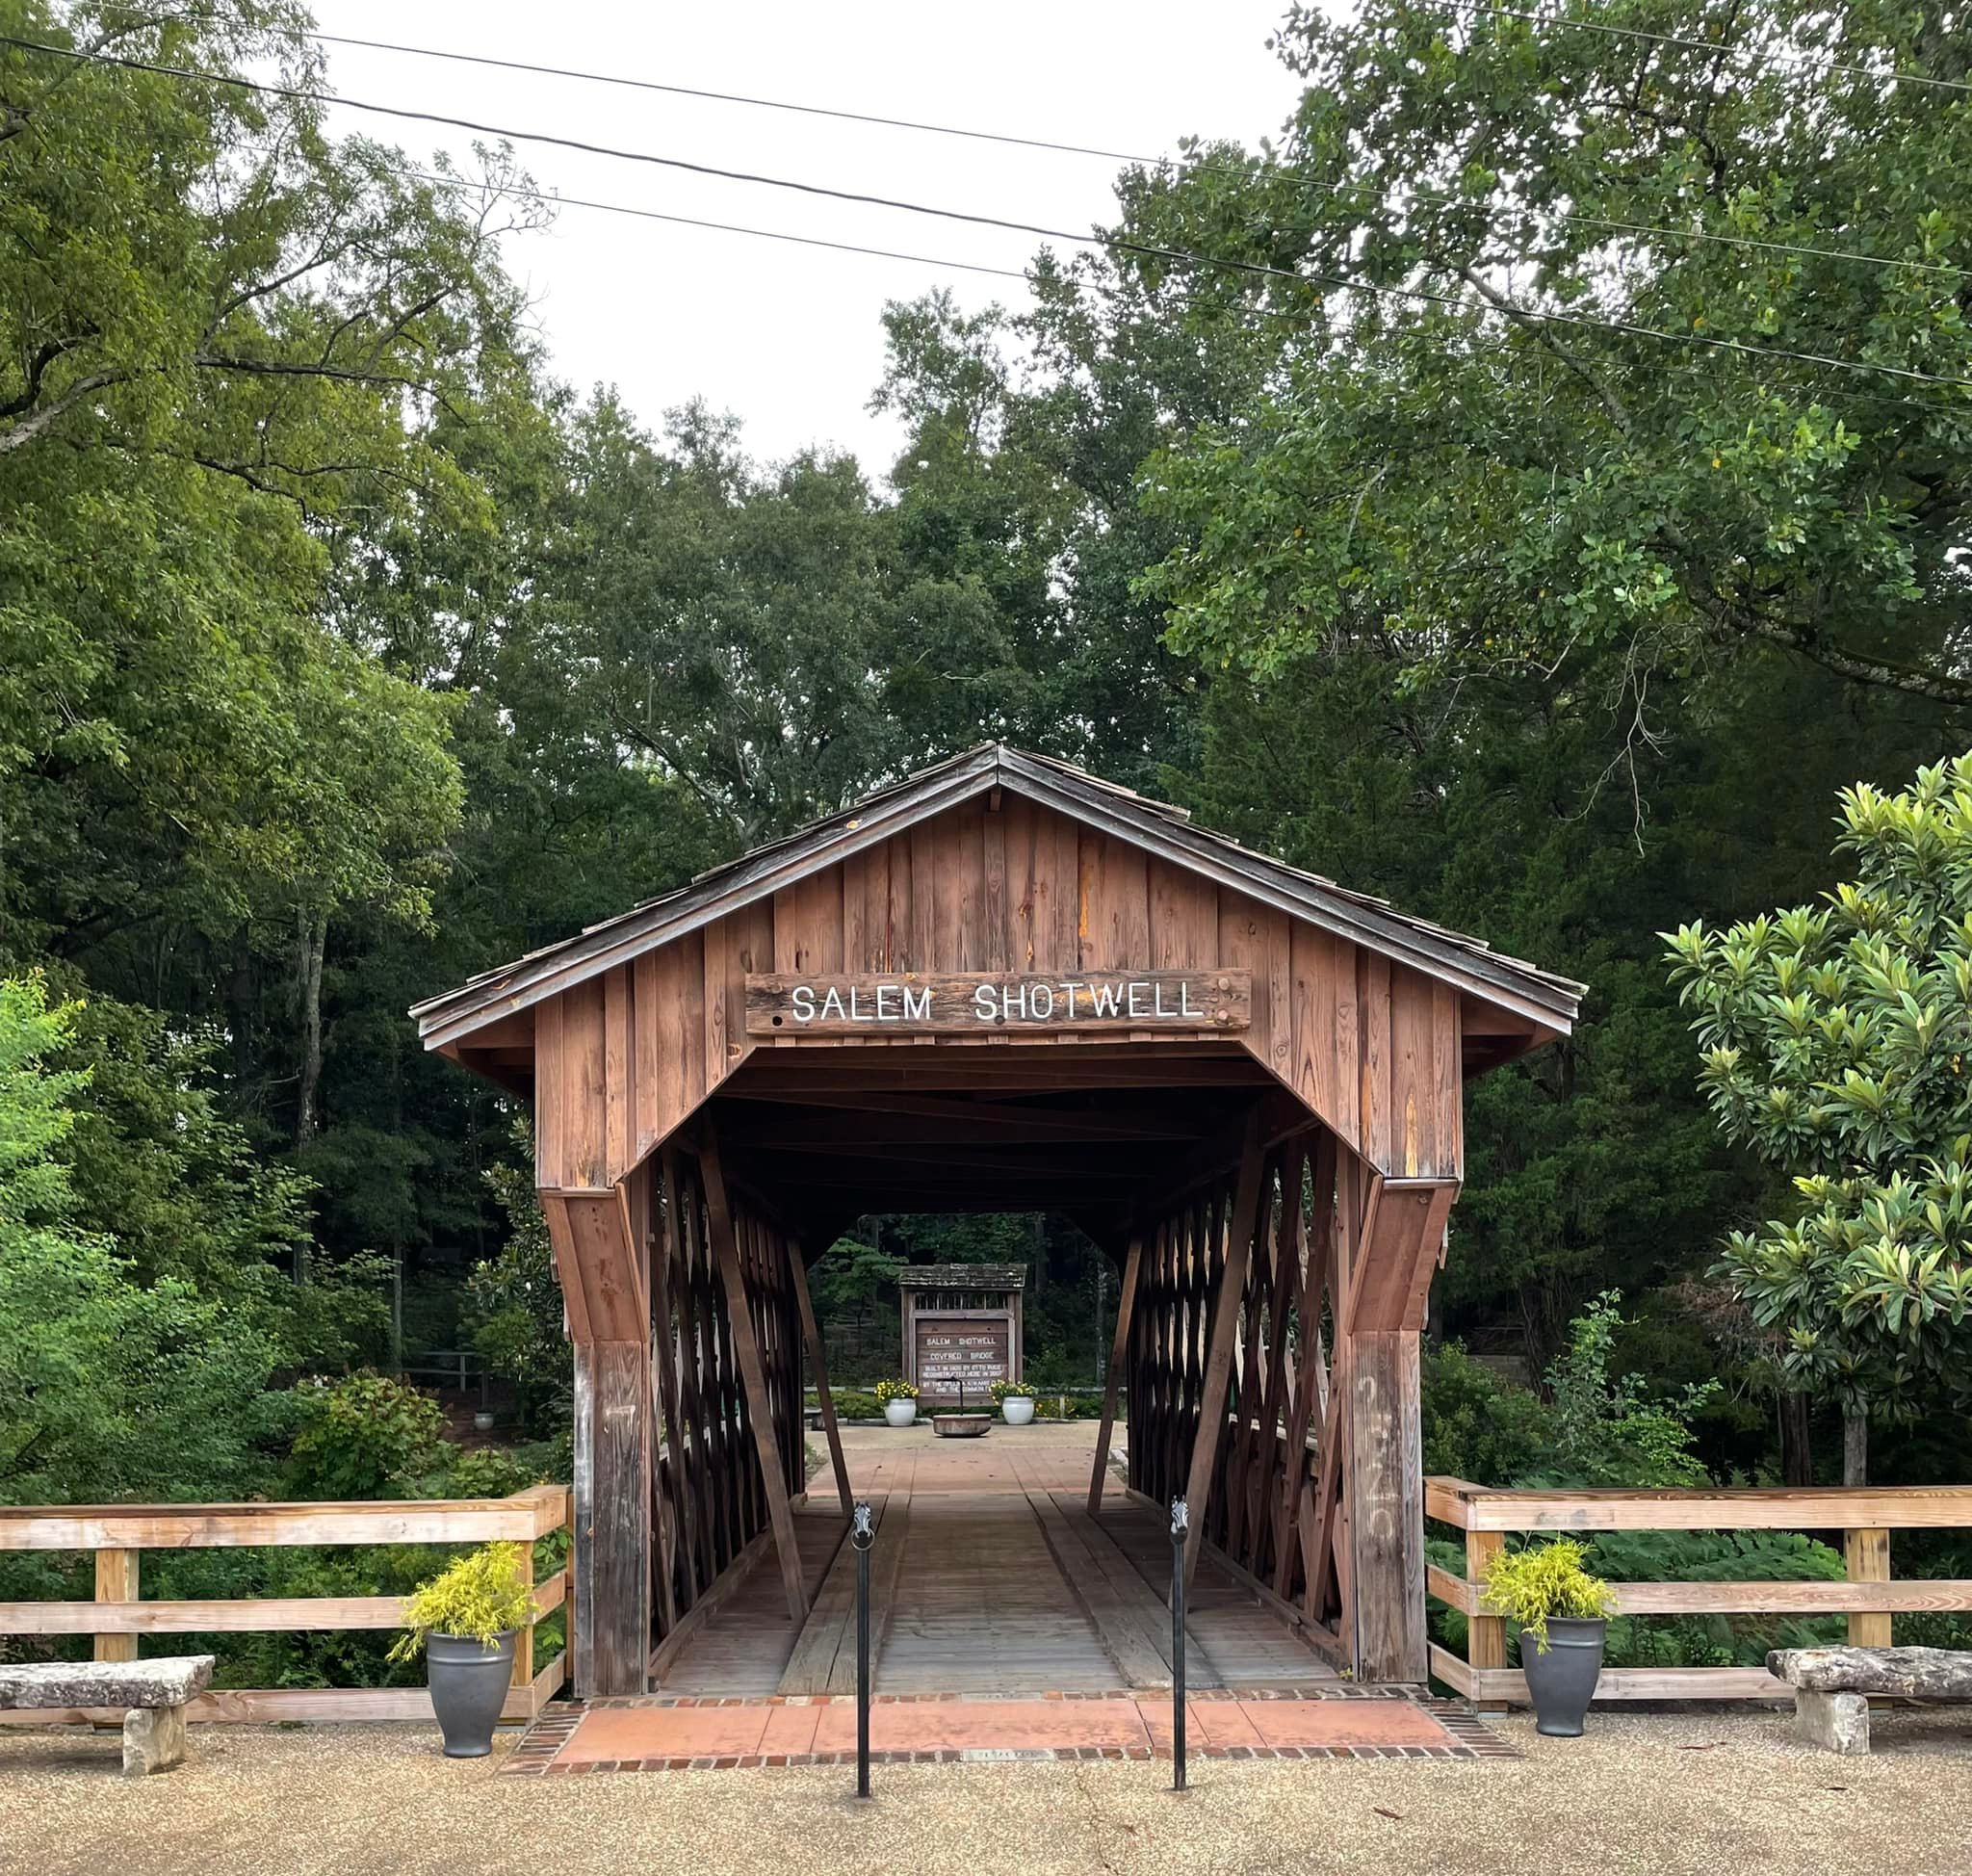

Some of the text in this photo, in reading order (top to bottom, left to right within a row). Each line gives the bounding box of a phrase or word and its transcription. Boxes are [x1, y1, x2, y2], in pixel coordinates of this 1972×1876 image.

[791, 981, 1204, 1022] SALEM SHOTWELL
[959, 1337, 996, 1345] SHOTWELL
